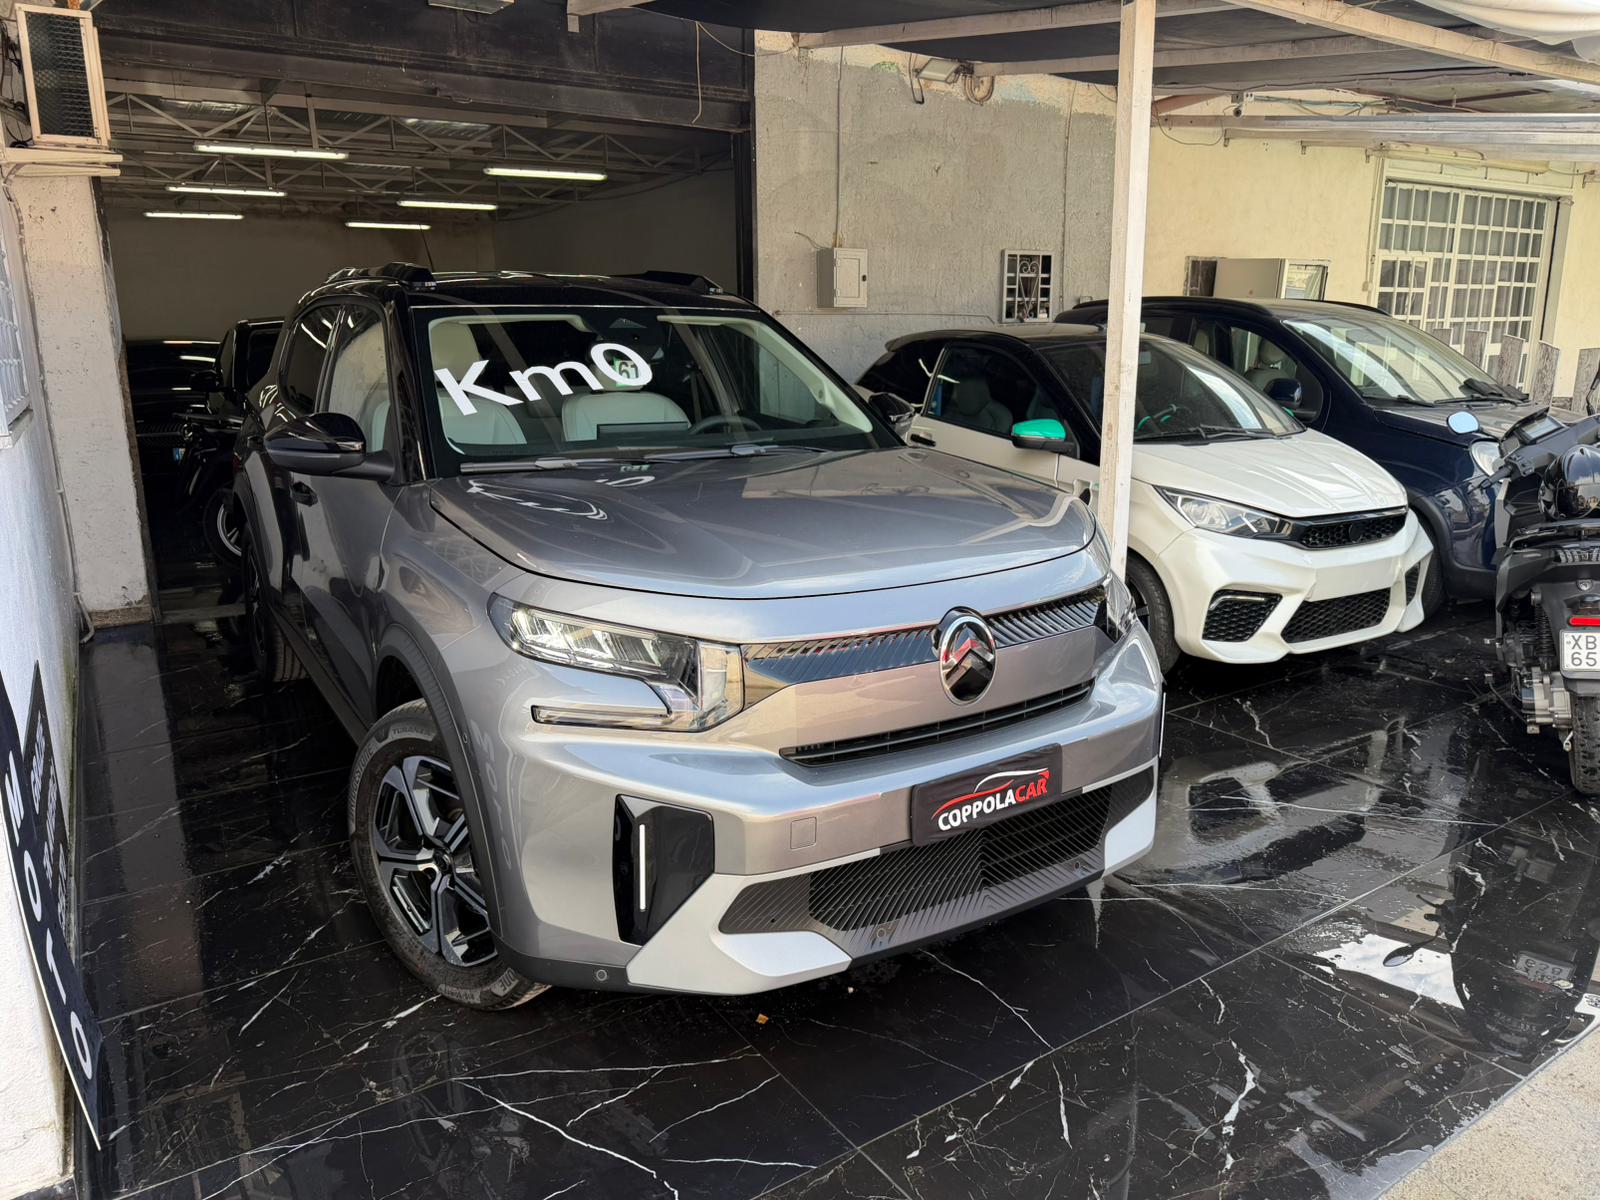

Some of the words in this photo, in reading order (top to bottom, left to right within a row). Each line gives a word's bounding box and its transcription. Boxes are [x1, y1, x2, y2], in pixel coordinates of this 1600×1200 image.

[1571, 634, 1598, 651] XB
[1571, 652, 1598, 667] 65
[4, 750, 95, 1081] MOTO
